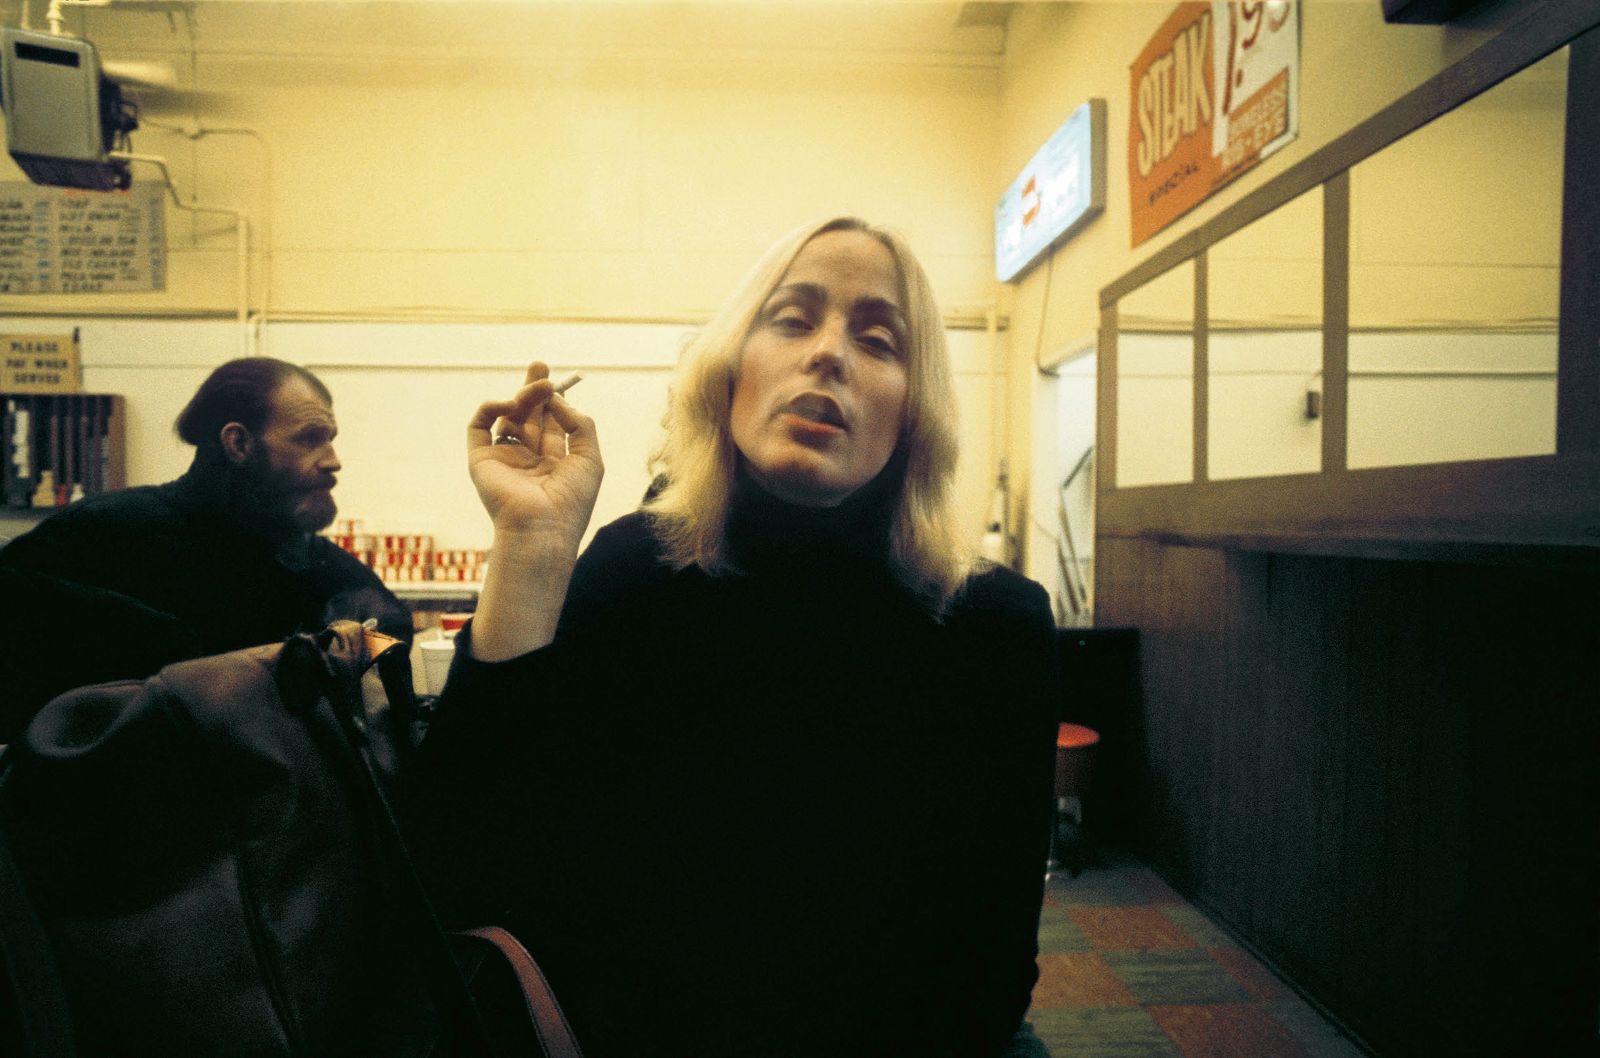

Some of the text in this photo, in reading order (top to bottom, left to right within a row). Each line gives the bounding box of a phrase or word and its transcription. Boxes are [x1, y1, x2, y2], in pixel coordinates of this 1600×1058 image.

[1137, 9, 1212, 179] STEAK
[10, 341, 58, 352] PLEASE
[34, 359, 68, 369] WHEN
[14, 373, 60, 384] SERVED
